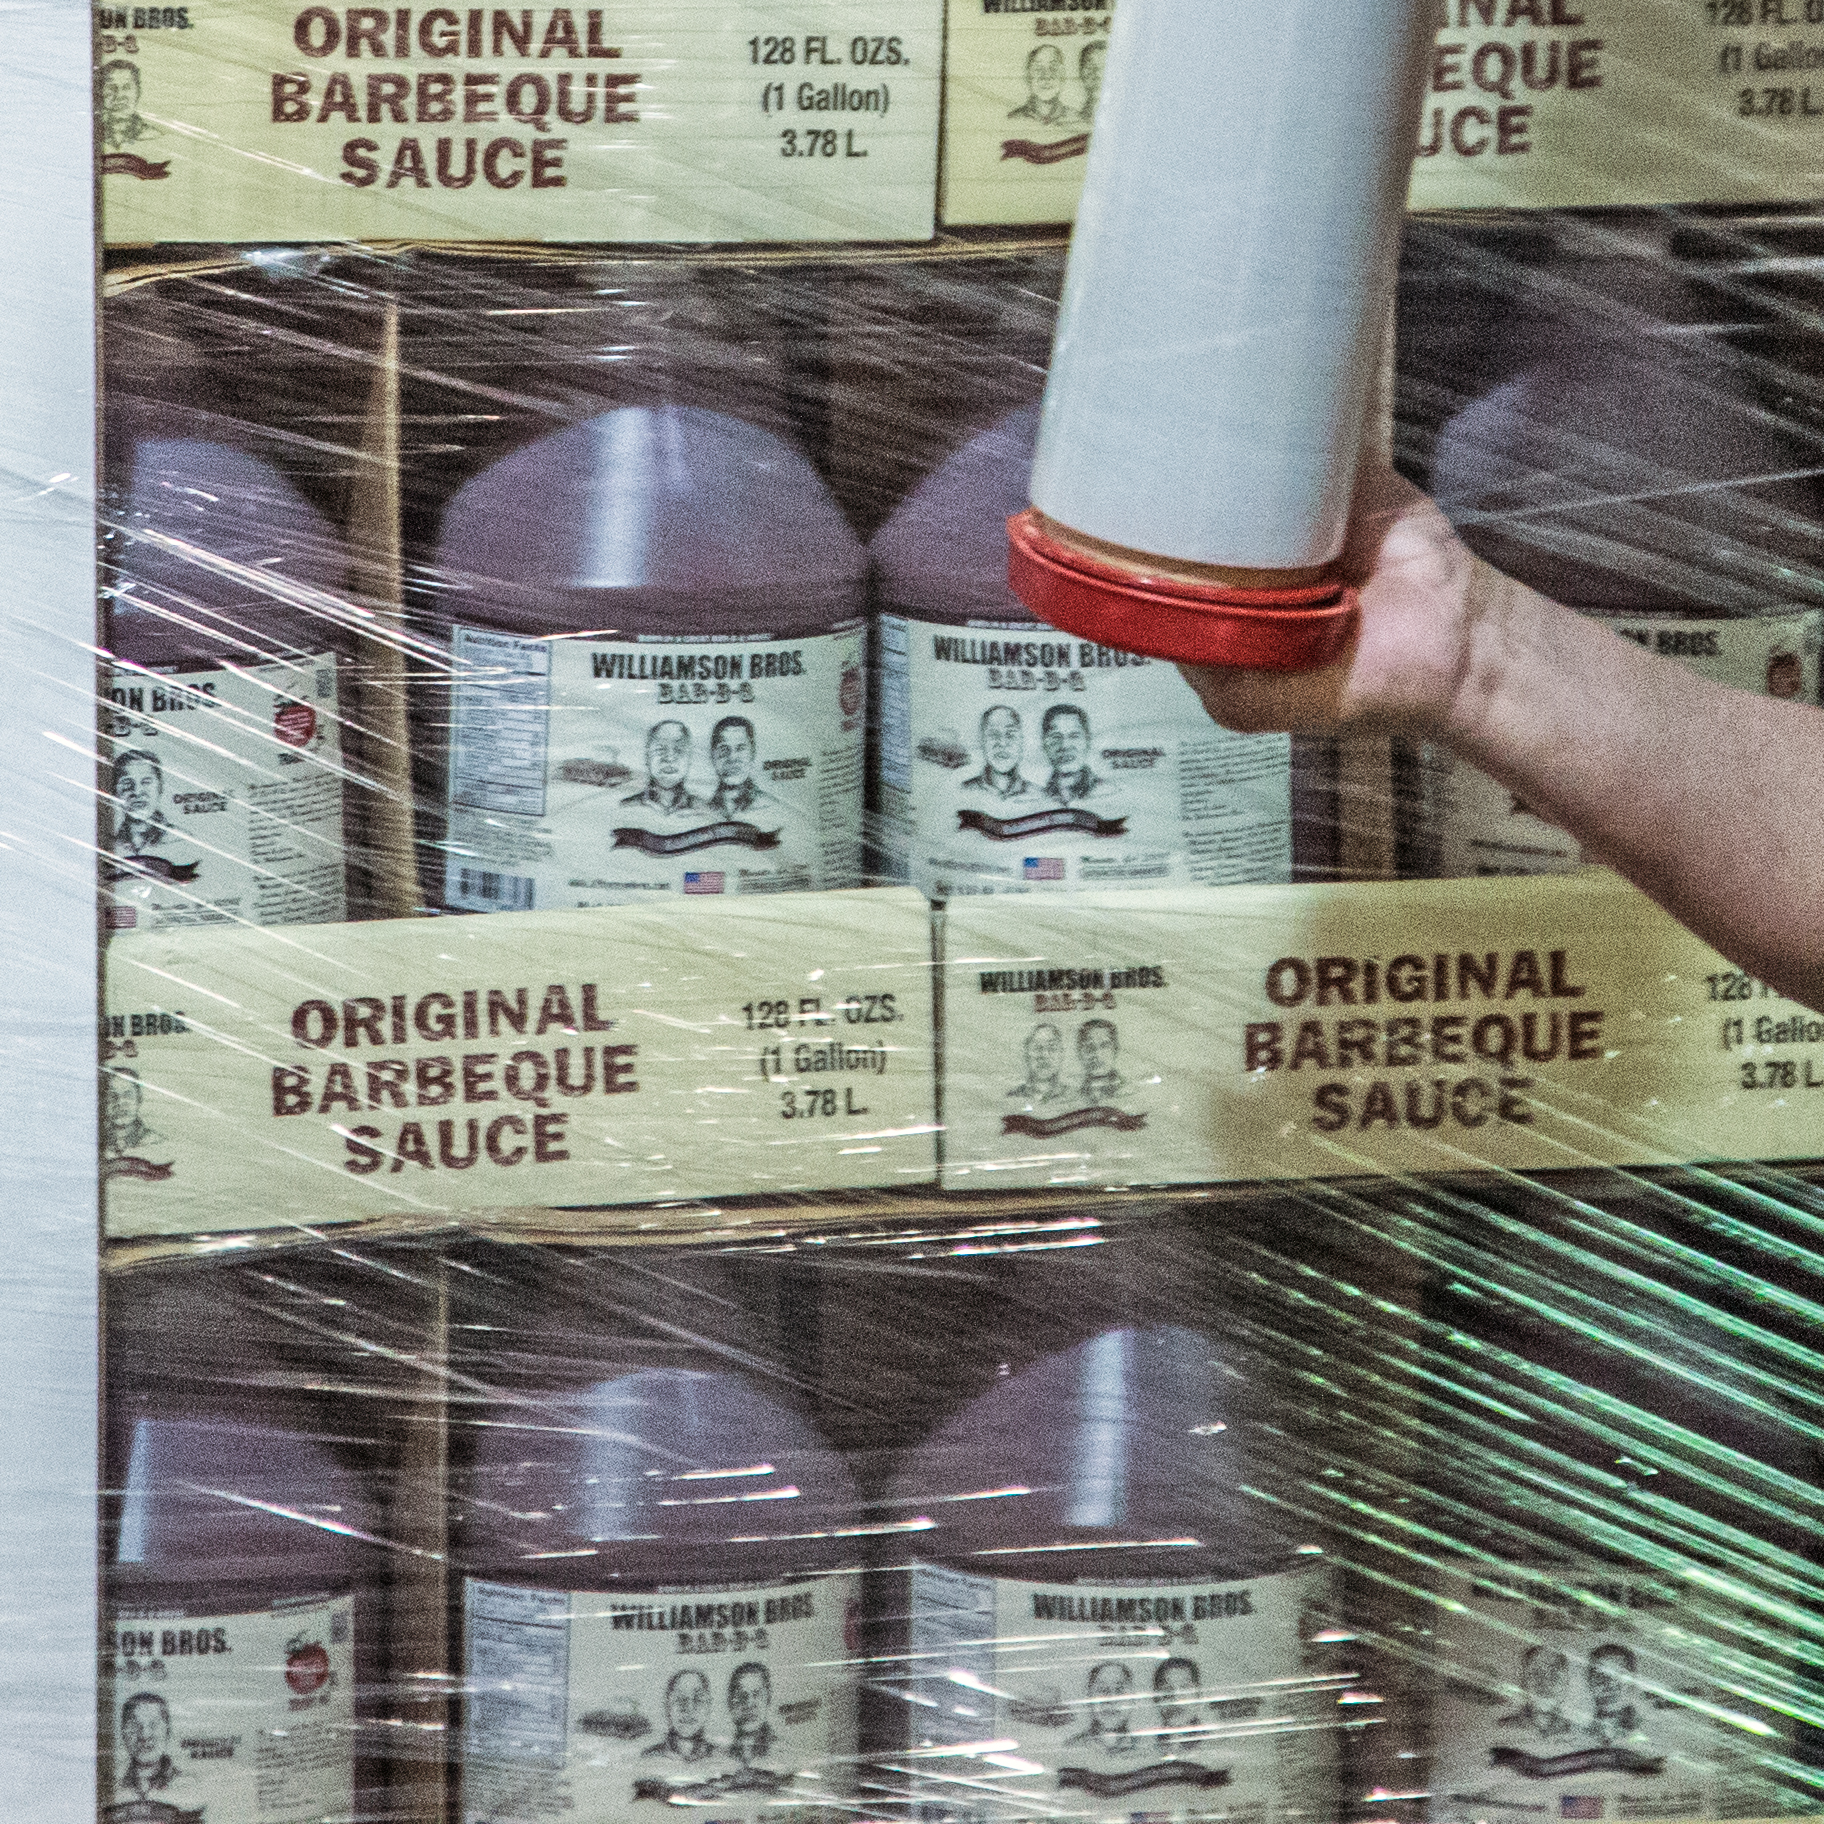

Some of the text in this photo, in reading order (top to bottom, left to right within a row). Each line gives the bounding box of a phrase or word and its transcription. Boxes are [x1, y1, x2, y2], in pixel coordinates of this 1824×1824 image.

[292, 6, 623, 59] ORIGINAL
[748, 36, 911, 65] 128 FL. OZS.
[1433, 38, 1604, 100] EQUE
[271, 72, 642, 133] BARBEQUE
[761, 82, 890, 118] (1 Gallon)
[780, 128, 838, 158] 3.78
[1419, 103, 1534, 158] UCE
[339, 137, 569, 189] SAUCE
[591, 650, 806, 680] WILLIAMSON BROS.
[933, 634, 1072, 667] WILLIAMSON
[978, 968, 1105, 995] WILLIAMSON
[1265, 949, 1587, 1008] ORIGINAL
[290, 984, 619, 1050] ORIGINAL
[742, 999, 792, 1031] 128
[843, 992, 905, 1024] OZS.
[760, 1039, 888, 1082] (1 Gallon)
[1243, 1011, 1605, 1072] BARBEQUE
[271, 1044, 641, 1118] BARBEQUE
[781, 1088, 838, 1120] 3.78
[1311, 1076, 1535, 1133] SAUCE
[342, 1113, 570, 1175] SAUCE
[610, 1603, 761, 1630] WILLIAMSON
[1033, 1592, 1186, 1623] WILLIAMSON
